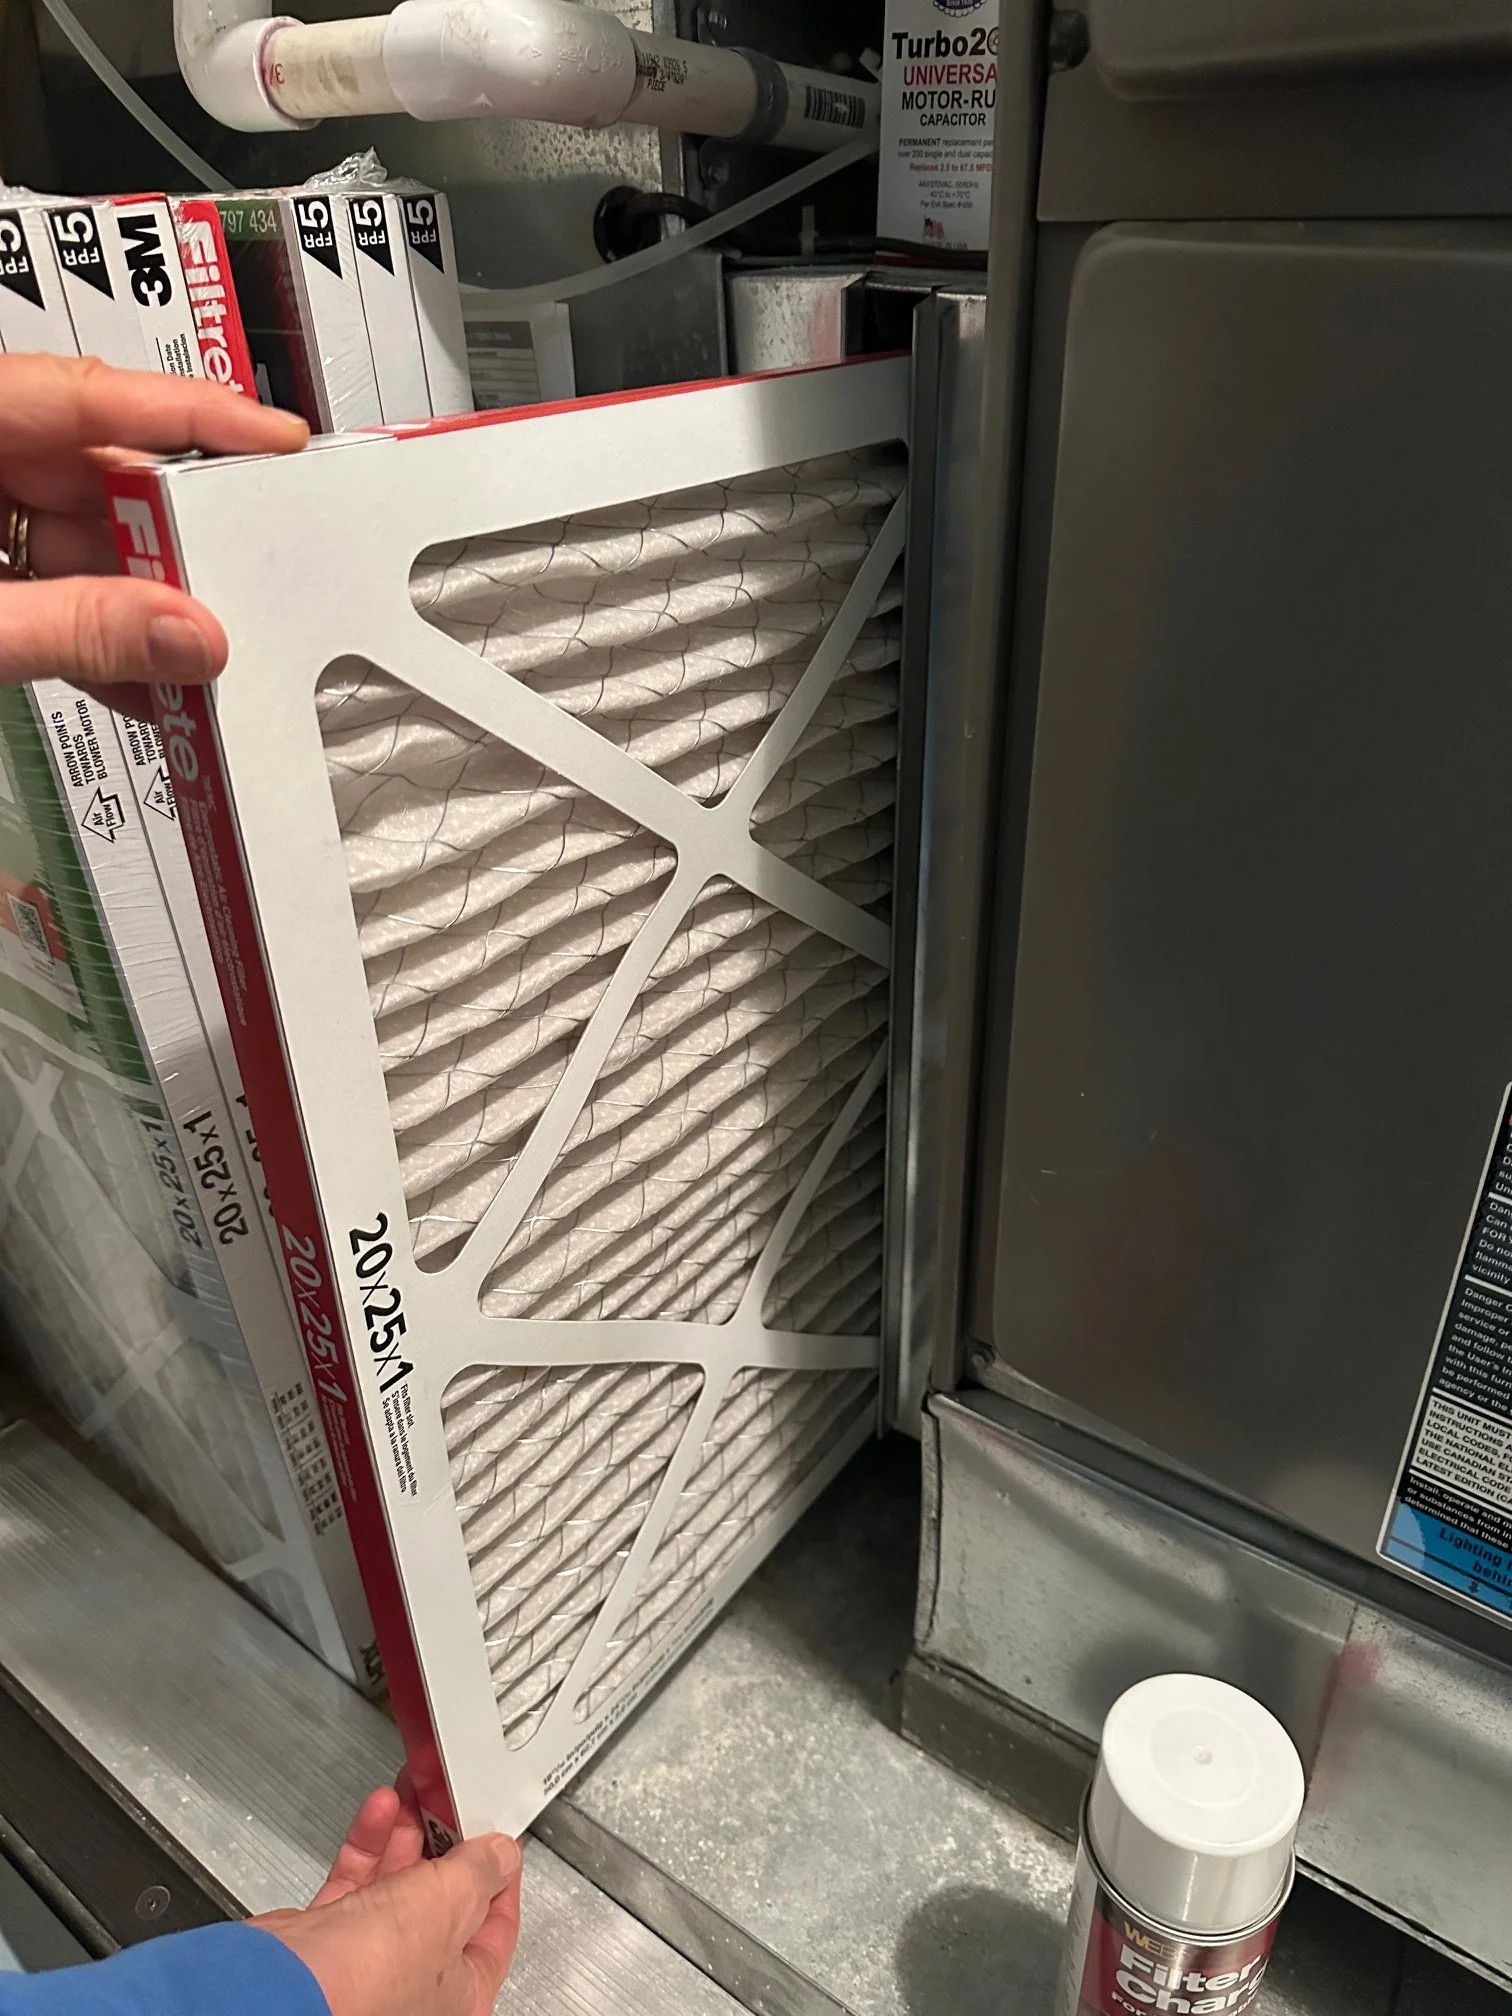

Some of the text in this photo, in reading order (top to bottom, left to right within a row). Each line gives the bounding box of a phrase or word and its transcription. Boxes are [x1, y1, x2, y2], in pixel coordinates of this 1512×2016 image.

[904, 63, 998, 86] UNIVERSA
[902, 90, 996, 110] MOTOR-RU
[920, 113, 986, 126] CAPACITOR
[899, 138, 993, 149] PERMANENT replacement pa
[952, 164, 959, 172] to
[250, 209, 277, 232] 434
[298, 200, 329, 229] 5
[353, 199, 383, 228] 5
[406, 199, 434, 226] 5
[54, 212, 93, 244] 5
[304, 232, 333, 248] FPR
[358, 230, 386, 246] FPR
[411, 229, 437, 244] FPR
[0, 256, 30, 275] FP
[63, 247, 100, 266] FPR
[117, 213, 172, 307] 3M
[165, 344, 174, 362] Date
[52, 710, 84, 787] ARROW POINTS
[75, 699, 108, 780] BLOWER MOTOR
[127, 731, 146, 766] ARROW
[73, 734, 95, 785] TOWARDS
[155, 790, 165, 804] Air
[93, 812, 104, 826] Air
[103, 803, 116, 827] Flow
[184, 1110, 250, 1245] 20x25x1
[1486, 1214, 1508, 1229] Can
[1479, 1239, 1494, 1251] Do
[1483, 1227, 1507, 1242] FOR
[1472, 1264, 1510, 1285] vicinity
[349, 1212, 414, 1394] 20x25x1
[1465, 1287, 1503, 1308] Danger
[283, 1223, 348, 1401] 20x25x1
[1461, 1299, 1509, 1323] Improper
[1455, 1323, 1499, 1347] damage,
[1458, 1312, 1510, 1337] service or
[1448, 1344, 1465, 1357] the
[1467, 1352, 1500, 1371] User's
[1451, 1334, 1505, 1360] and follow
[1445, 1356, 1467, 1369] with
[1469, 1365, 1489, 1379] this
[1438, 1378, 1508, 1411] agency or the
[1442, 1366, 1511, 1400] be performed
[383, 1397, 391, 1409] Se
[385, 1408, 394, 1433] adapta
[397, 1419, 405, 1436] dans
[406, 1413, 415, 1428] slot
[1429, 1410, 1504, 1447] INSTRUCTIONS
[1433, 1400, 1512, 1439] THIS UNIT MUST
[391, 1435, 398, 1447] la
[400, 1433, 407, 1444] le
[1425, 1429, 1444, 1443] THE
[1446, 1438, 1496, 1466] NATIONAL
[1427, 1419, 1459, 1439] LOCAL
[1462, 1435, 1500, 1458] CODES,
[392, 1444, 401, 1468] ranura
[402, 1441, 414, 1474] logement
[1421, 1438, 1442, 1451] USE
[1443, 1448, 1496, 1476] CANADIAN
[397, 1465, 405, 1478] del
[408, 1472, 415, 1482] du
[1416, 1456, 1452, 1478] LATEST
[1454, 1474, 1495, 1497] EDITION
[1418, 1447, 1512, 1494] ELECTRICAL CODE
[399, 1475, 407, 1493] filtro
[1407, 1487, 1418, 1496] or
[1419, 1493, 1475, 1523] substances
[1477, 1518, 1500, 1535] from
[1410, 1477, 1501, 1524] Install, operate and
[1404, 1496, 1509, 1550] determined that these
[1439, 1527, 1502, 1567] Lighting
[1121, 1944, 1262, 1992] Filter
